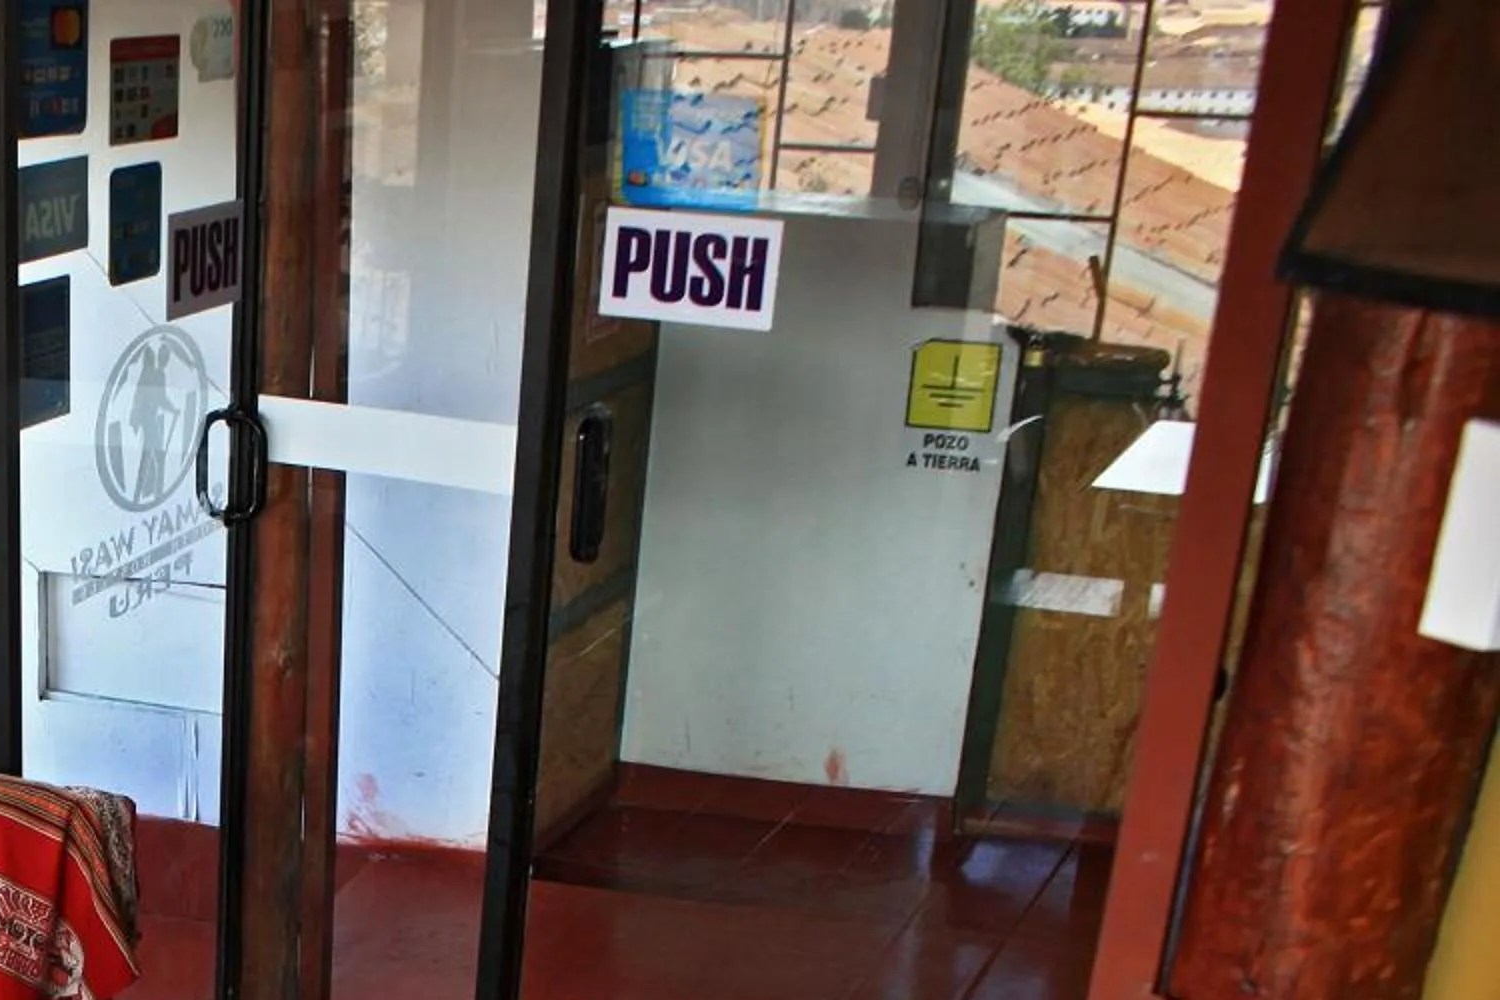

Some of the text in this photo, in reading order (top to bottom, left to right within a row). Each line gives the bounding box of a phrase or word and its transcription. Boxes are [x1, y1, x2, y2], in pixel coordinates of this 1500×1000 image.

[654, 133, 733, 172] VISA
[173, 217, 240, 304] PUSH
[612, 226, 769, 312] PUSH
[923, 434, 970, 450] POZO
[906, 452, 981, 472] A TIERRA
